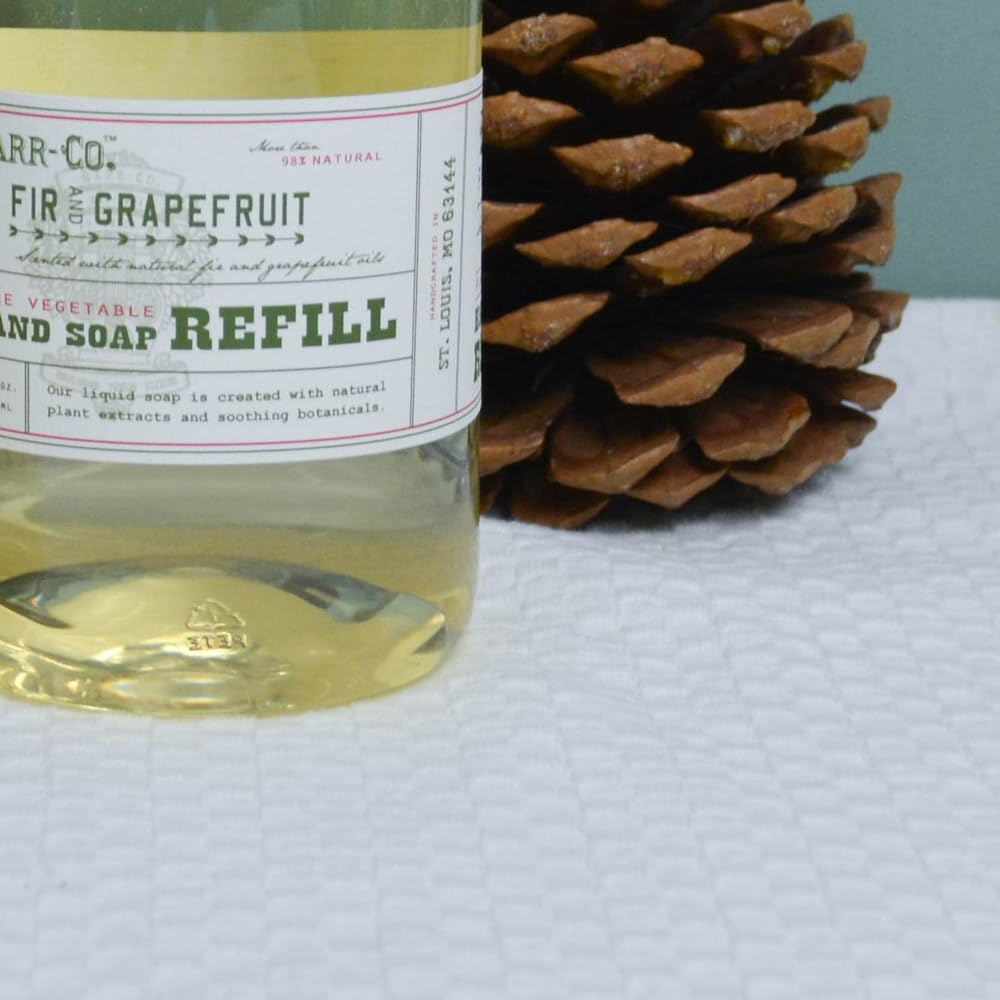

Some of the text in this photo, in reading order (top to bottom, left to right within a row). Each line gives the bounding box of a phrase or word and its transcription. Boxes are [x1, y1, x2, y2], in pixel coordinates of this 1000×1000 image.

[250, 139, 320, 152] More than
[281, 151, 382, 167] 98% NATURAL
[11, 184, 310, 228] FIR AND GRAPEFRUIT
[16, 248, 385, 284] Scented with natural fir and grapefruit oils
[430, 212, 438, 320] HANDCRAFTED IN
[439, 155, 456, 371] ST. LOUIS, MO 63144
[28, 296, 154, 318] VEGETABLE
[65, 322, 157, 350] SOAP
[171, 297, 397, 350] REFILL
[47, 380, 386, 405] Our liquid soap is created with natural
[47, 402, 385, 423] plant extracts and soothing botanicals.
